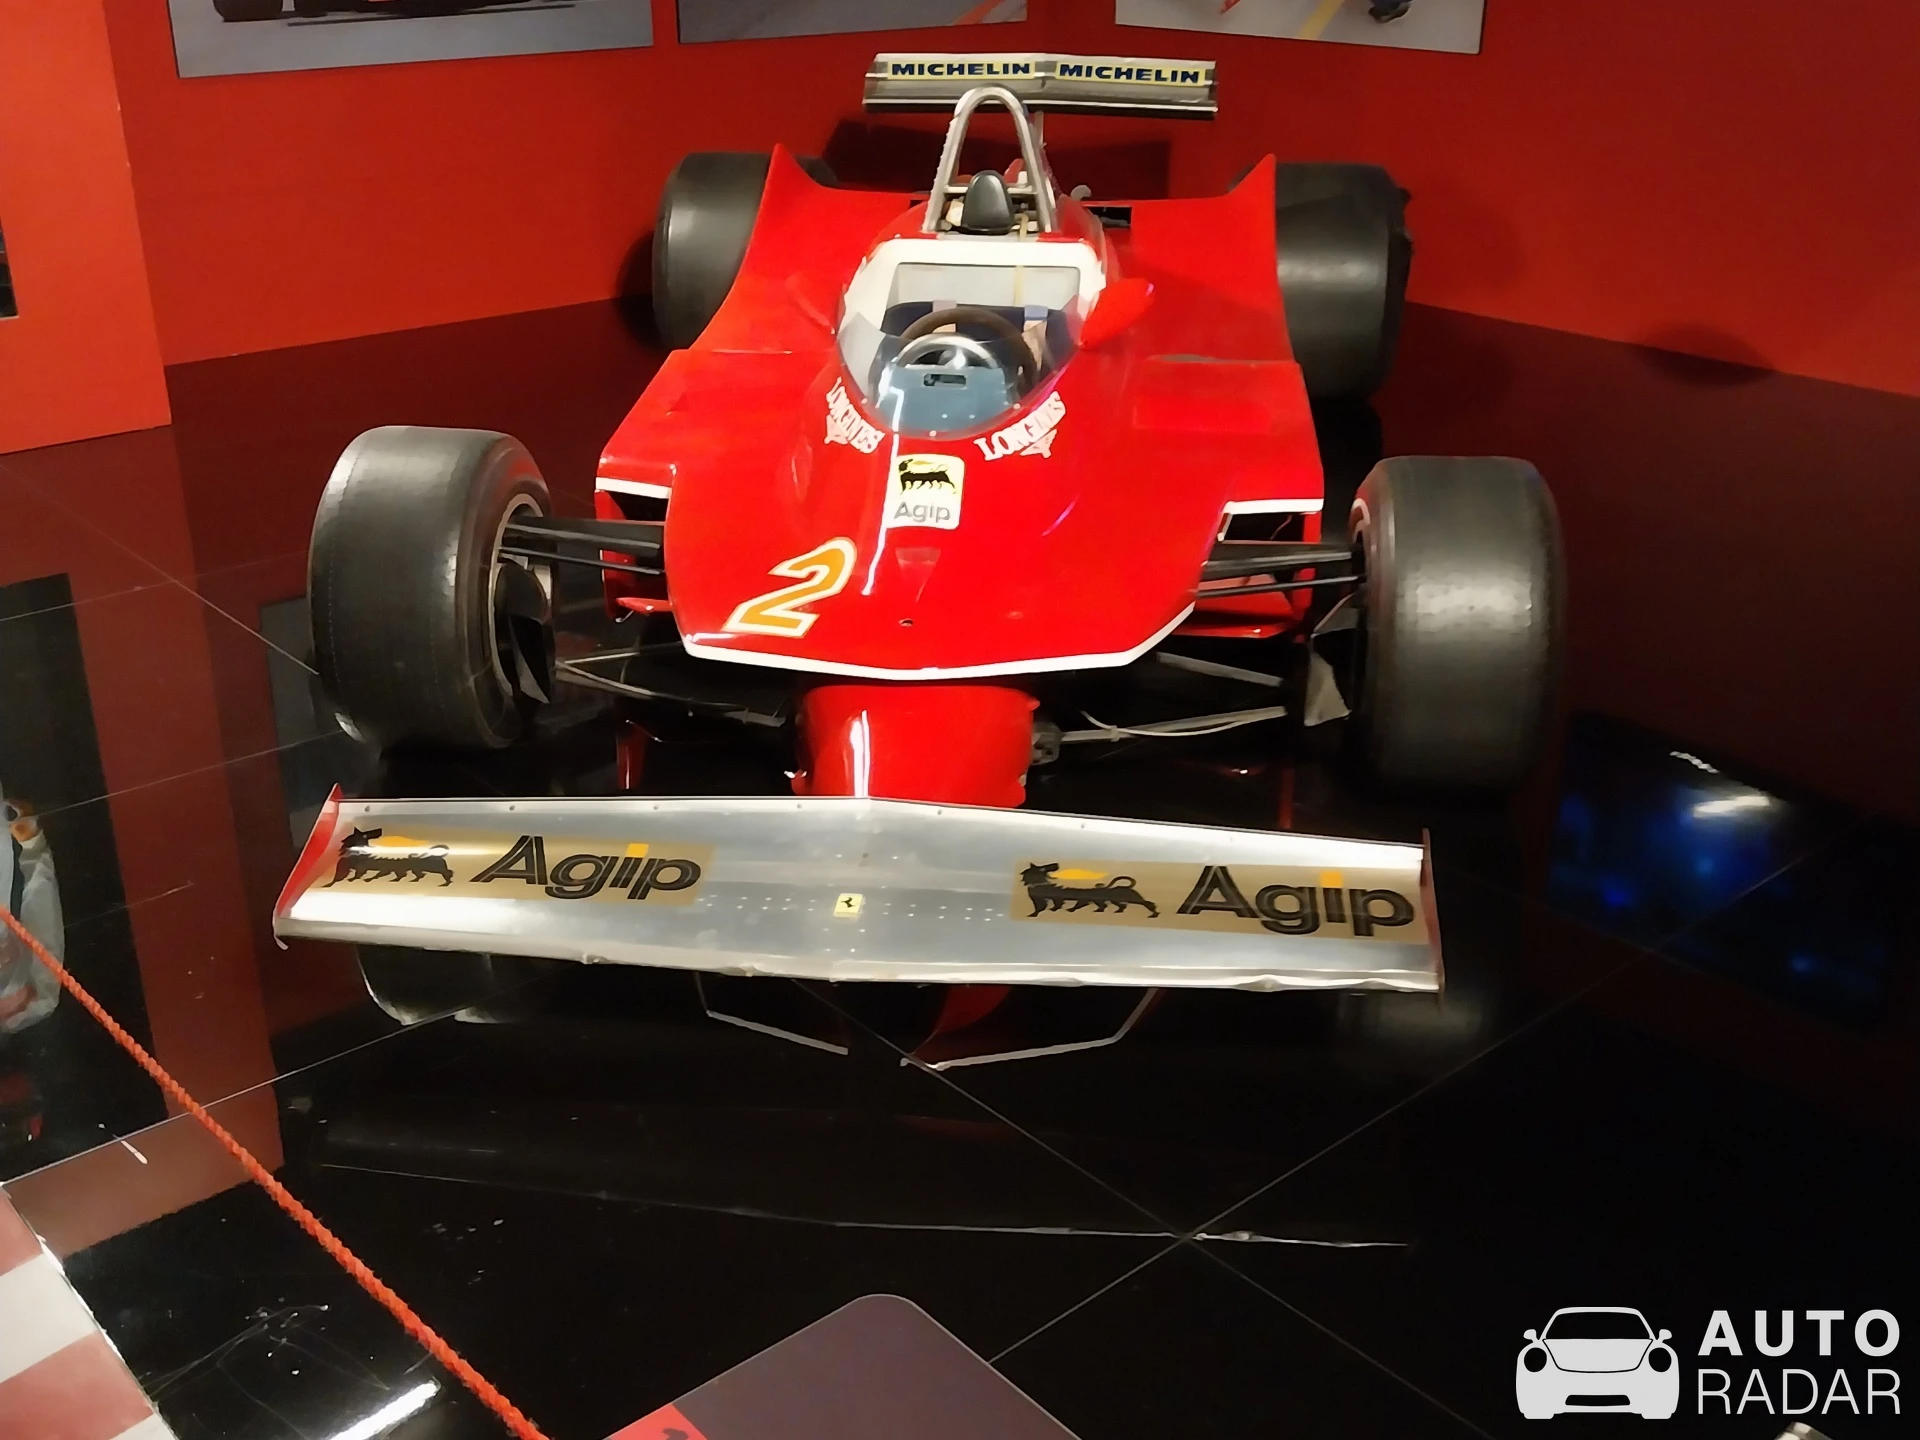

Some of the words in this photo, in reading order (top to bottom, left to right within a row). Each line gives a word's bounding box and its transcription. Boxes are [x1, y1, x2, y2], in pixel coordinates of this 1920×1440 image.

[891, 62, 1031, 76] MICHELIN
[1059, 63, 1200, 84] MICHELIN
[894, 500, 951, 522] Agip
[721, 537, 857, 638] 2
[469, 835, 702, 900] Agip
[1176, 865, 1415, 936] Agip
